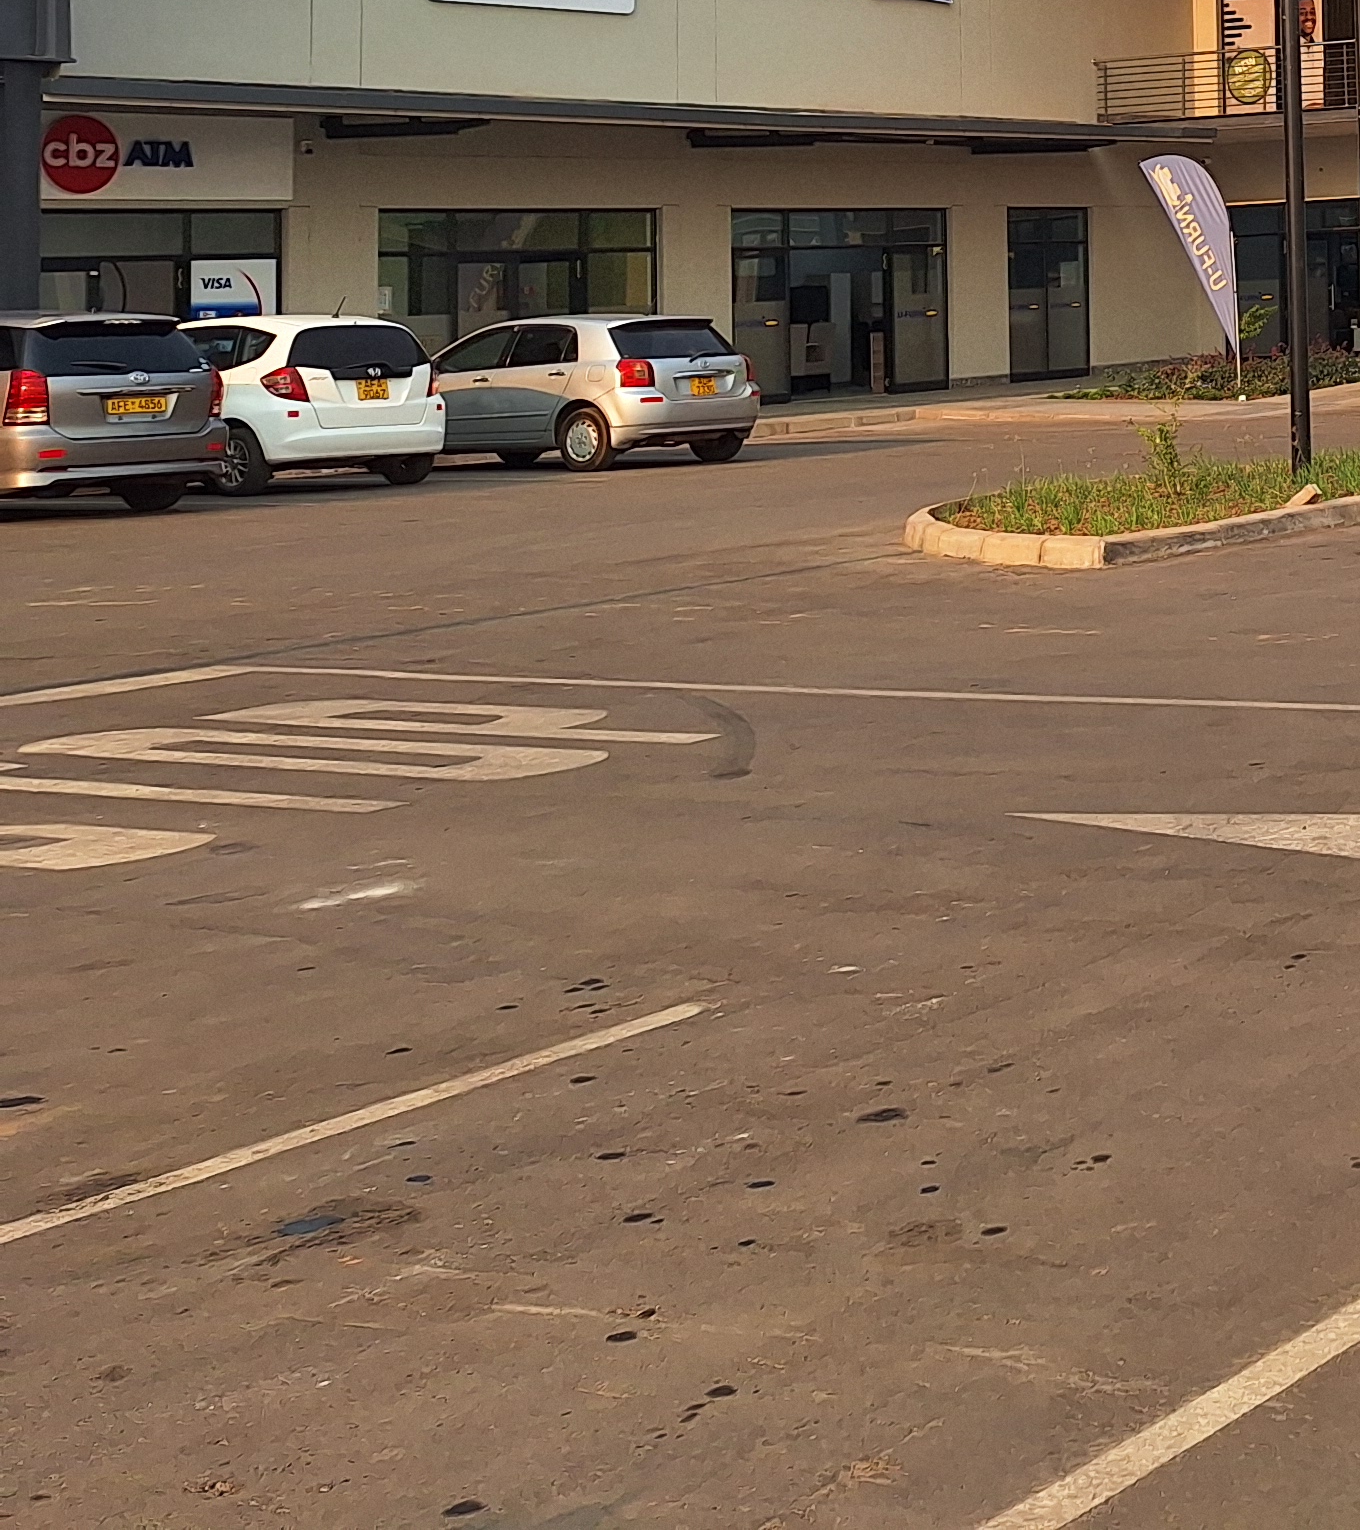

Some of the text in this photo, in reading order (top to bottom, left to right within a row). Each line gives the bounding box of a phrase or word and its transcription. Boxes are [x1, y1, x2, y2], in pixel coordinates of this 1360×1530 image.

[43, 132, 194, 168] cbz ATM
[199, 277, 233, 290] VISA
[111, 400, 130, 412] AFE
